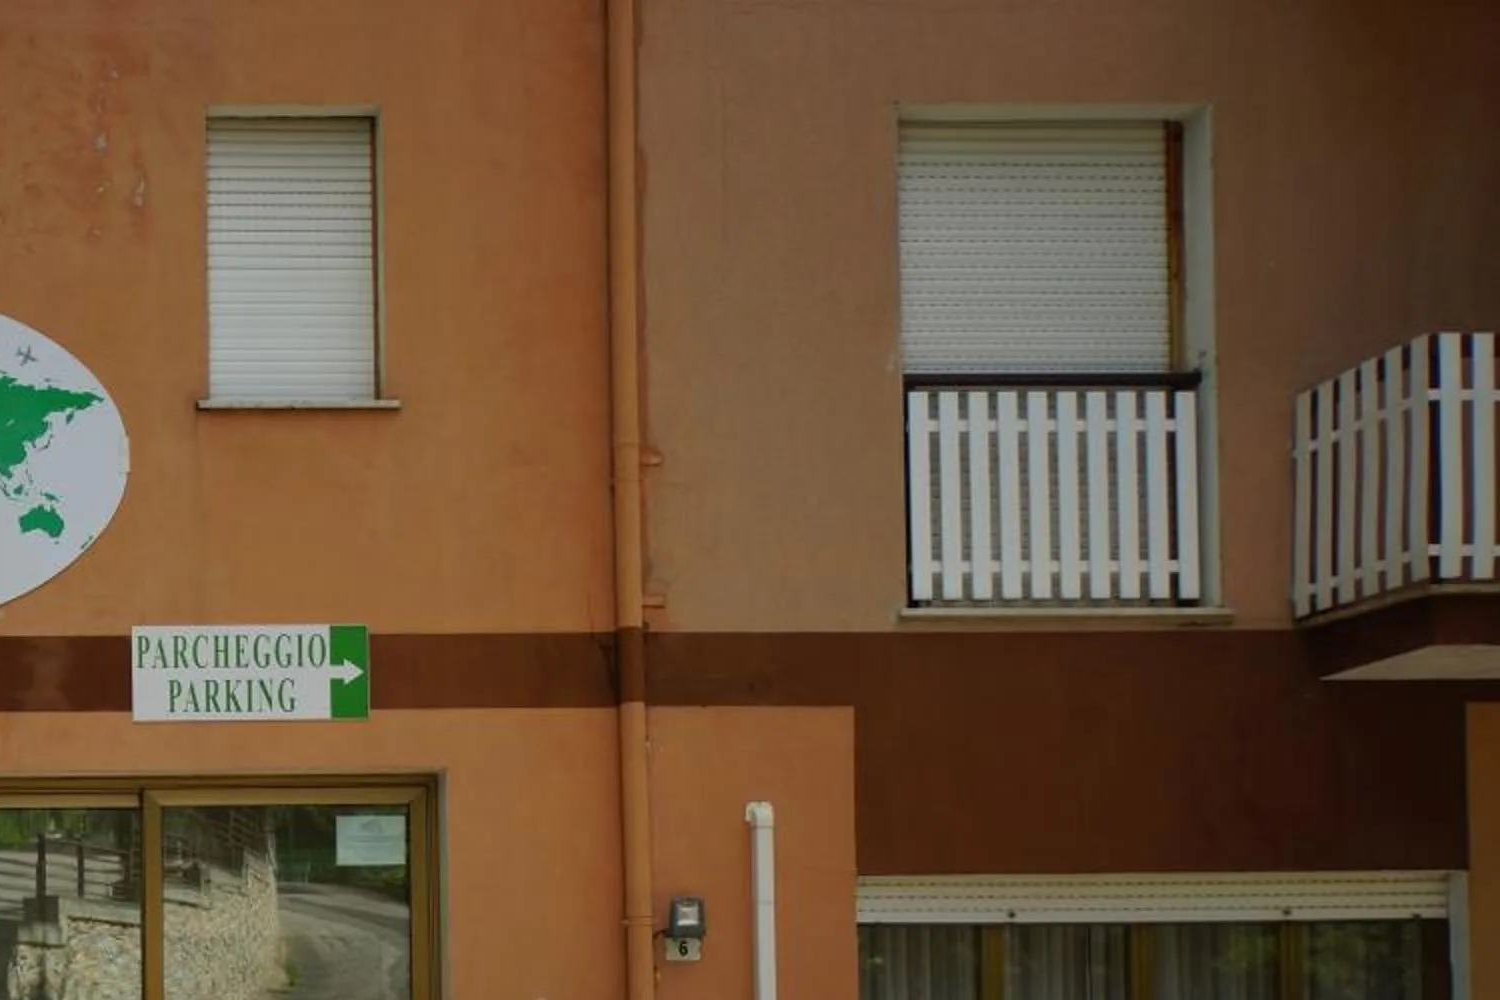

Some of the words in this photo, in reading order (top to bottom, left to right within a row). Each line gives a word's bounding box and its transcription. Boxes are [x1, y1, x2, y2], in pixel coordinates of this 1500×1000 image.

[135, 633, 327, 669] PARCHEGGIO
[168, 677, 296, 713] PARKING
[678, 940, 689, 957] 6
